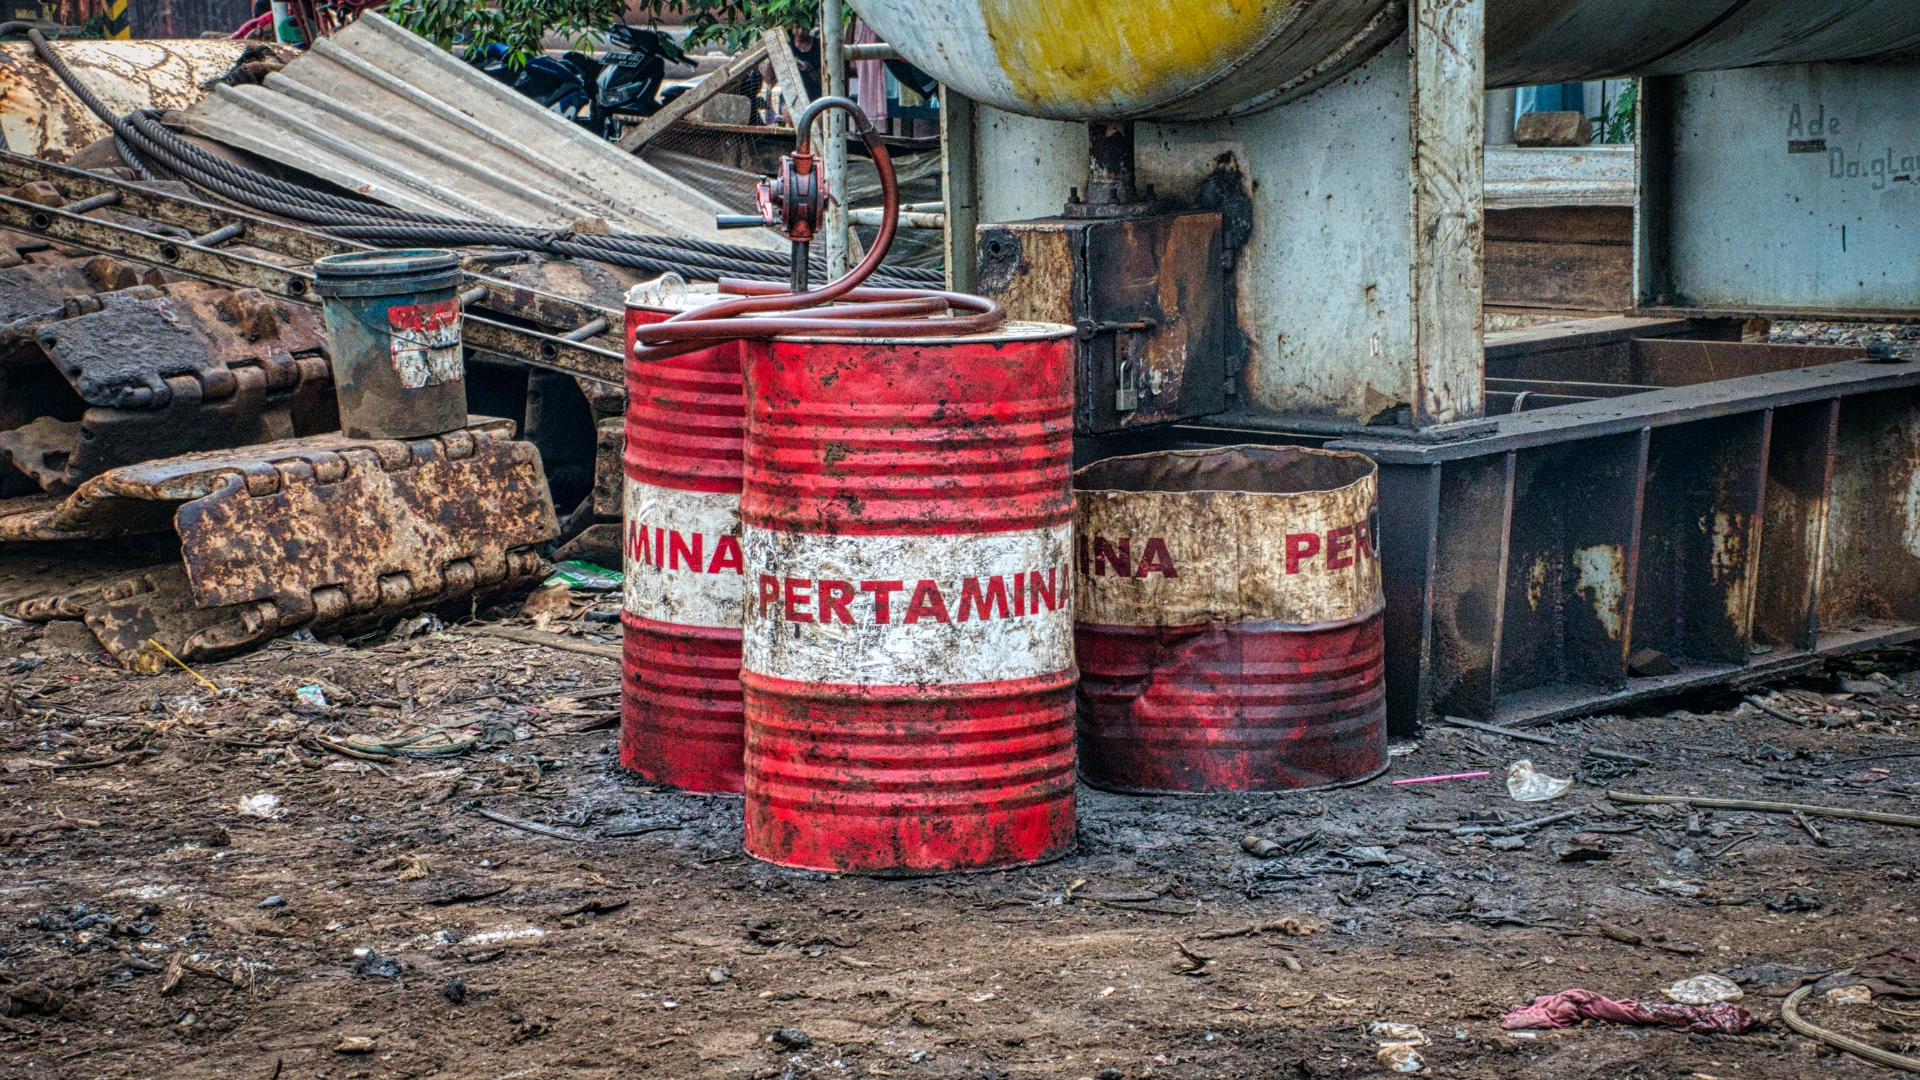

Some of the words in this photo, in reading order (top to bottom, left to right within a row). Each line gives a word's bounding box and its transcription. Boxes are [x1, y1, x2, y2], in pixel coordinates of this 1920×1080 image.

[1786, 103, 1841, 137] Ade
[624, 515, 744, 576] MINA
[1074, 532, 1179, 579] INA
[759, 562, 1070, 625] PERTAMINA
